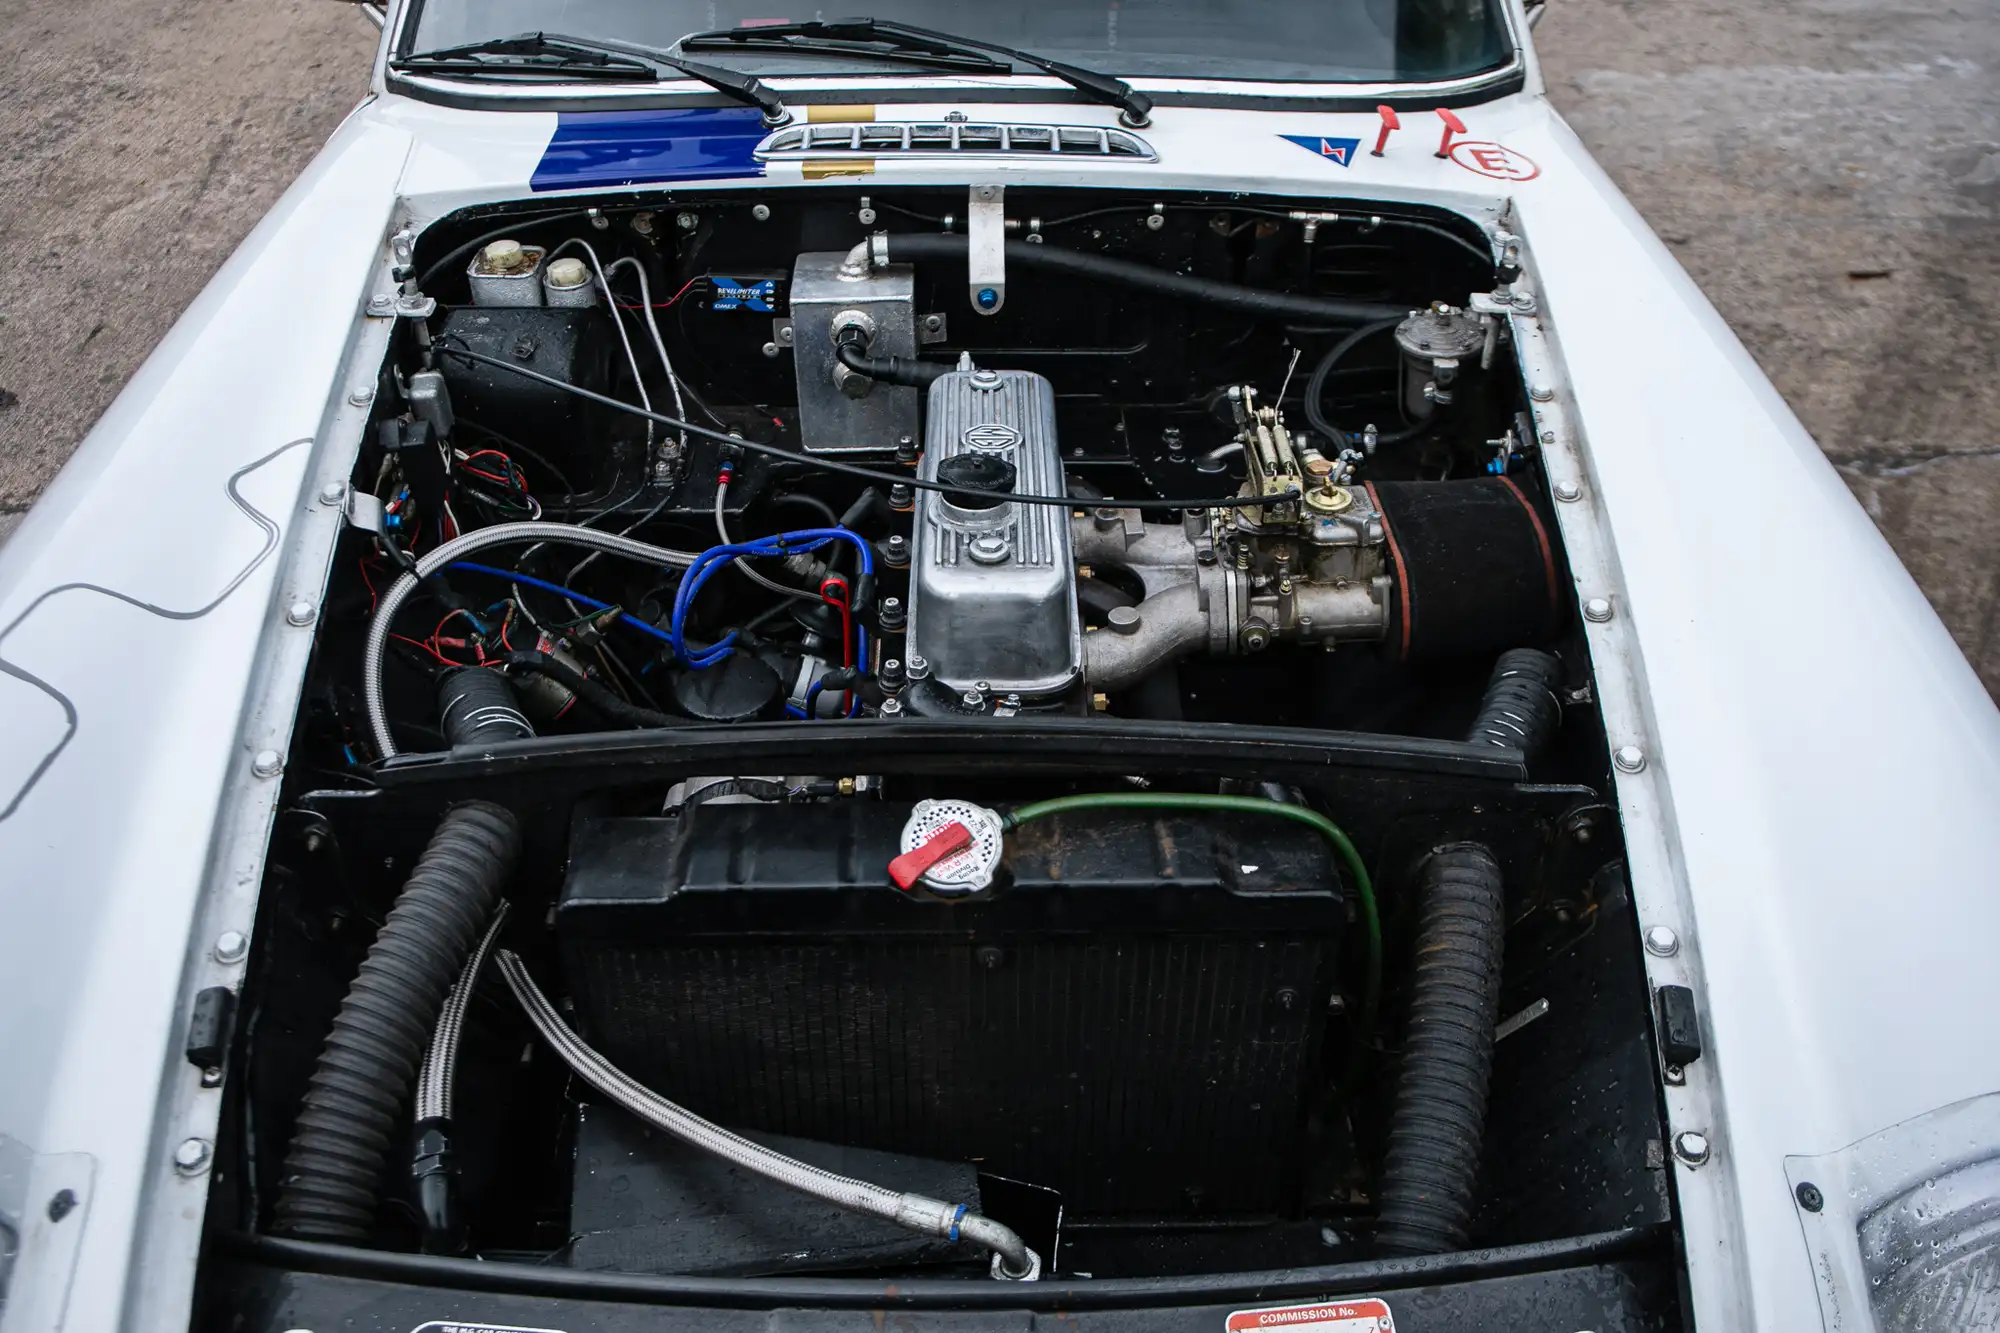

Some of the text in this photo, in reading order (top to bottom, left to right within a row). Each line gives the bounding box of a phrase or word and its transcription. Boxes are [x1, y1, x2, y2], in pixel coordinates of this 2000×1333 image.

[1469, 149, 1519, 174] E
[946, 863, 971, 879] Division
[959, 865, 980, 879] Racing
[1260, 1307, 1358, 1324] COMMISSION No.
